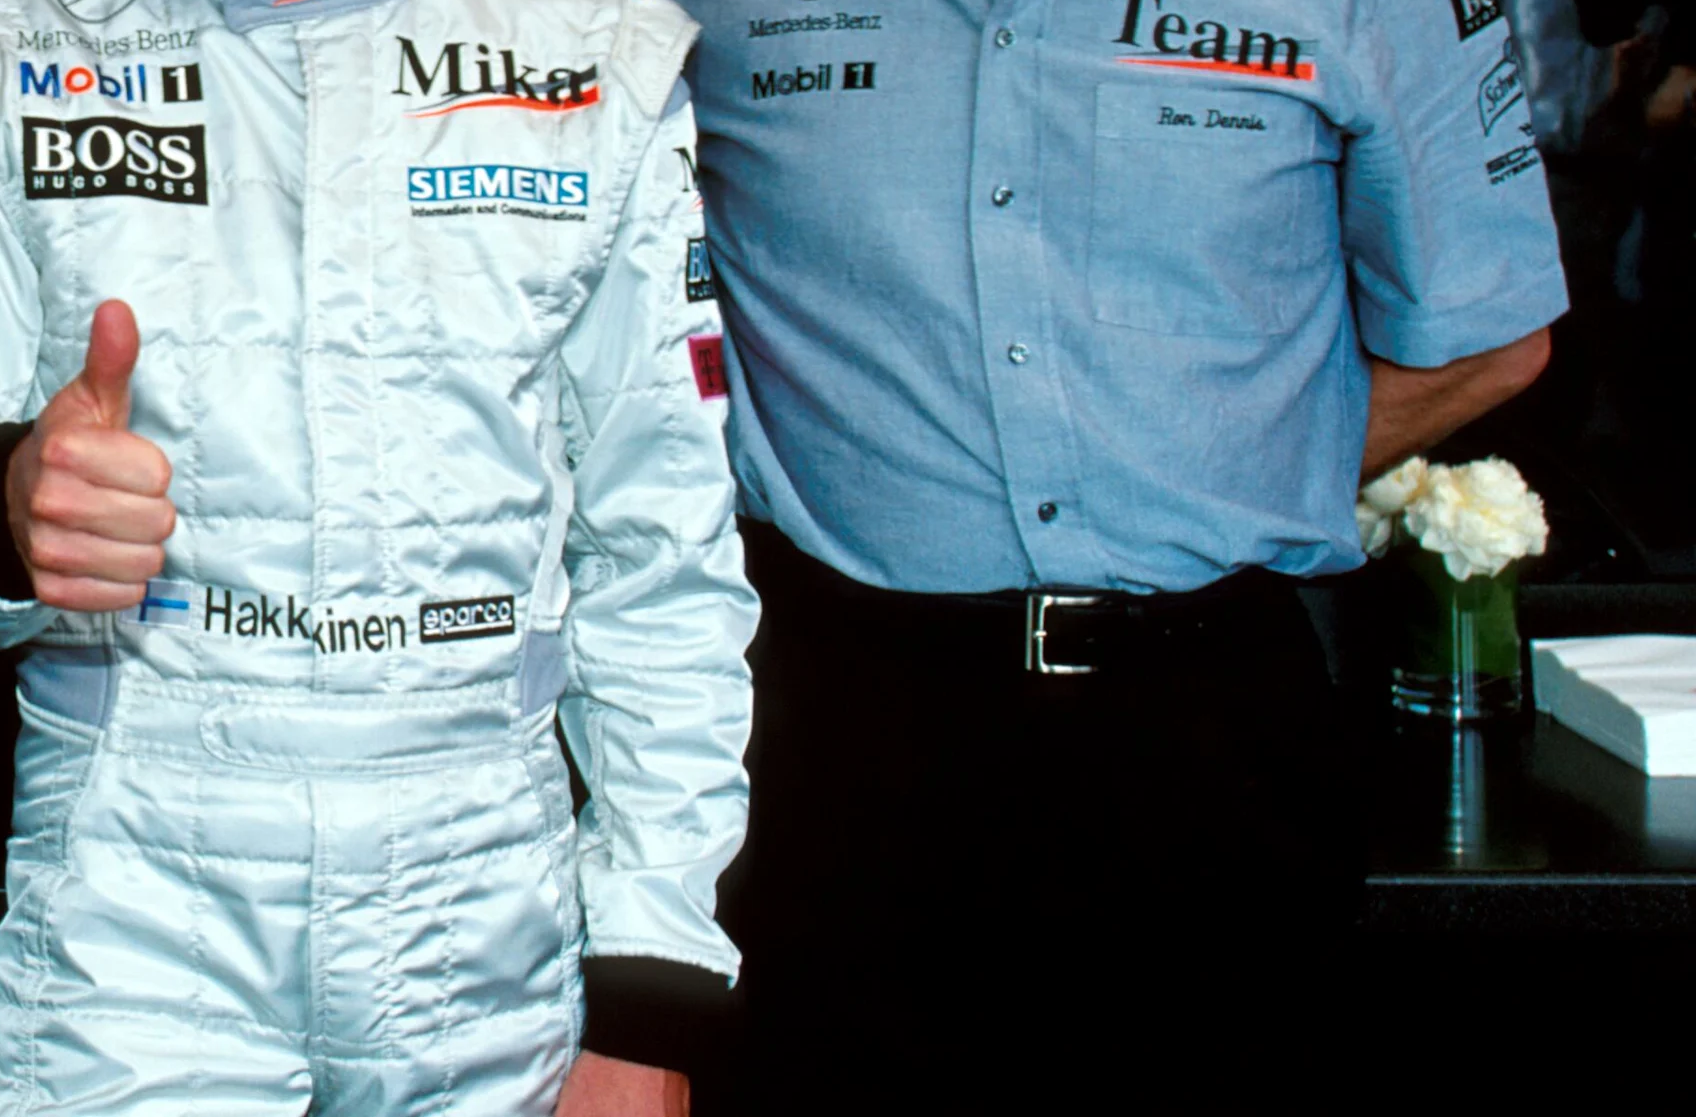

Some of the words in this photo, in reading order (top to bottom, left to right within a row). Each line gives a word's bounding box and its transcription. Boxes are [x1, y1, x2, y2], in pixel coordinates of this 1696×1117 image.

[20, 61, 147, 103] Mobil
[391, 36, 586, 105] Mika
[752, 64, 833, 100] Mobil
[1158, 107, 1196, 127] Ron
[1204, 109, 1267, 132] Dennis
[31, 125, 197, 180] BOSS
[33, 174, 107, 190] HUGO
[126, 174, 195, 196] BOSS
[410, 167, 585, 205] SIEMENS
[422, 600, 512, 631] sparco
